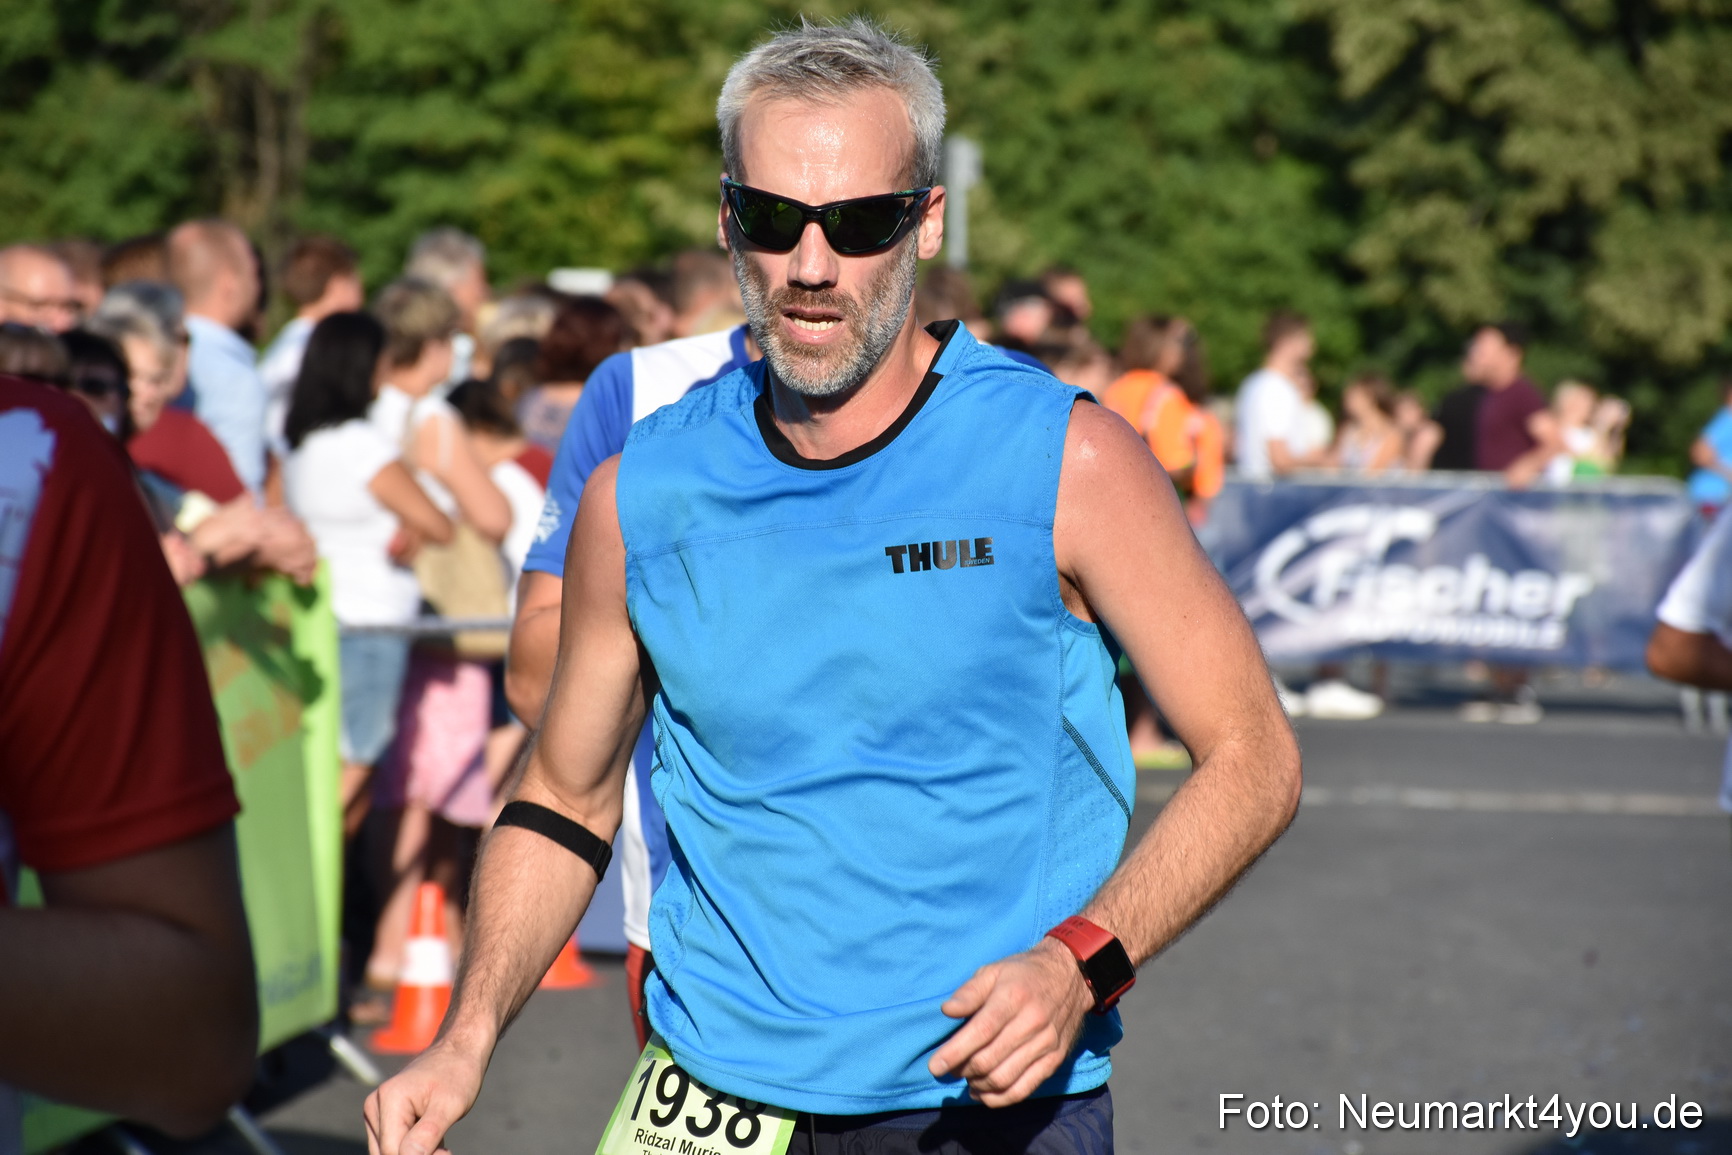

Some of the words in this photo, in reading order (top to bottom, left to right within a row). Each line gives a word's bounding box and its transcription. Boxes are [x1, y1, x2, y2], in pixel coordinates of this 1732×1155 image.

[885, 537, 994, 573] THULE
[1311, 550, 1592, 622] Fischer
[631, 1060, 767, 1149] 1938
[634, 1128, 676, 1151] Ridzal
